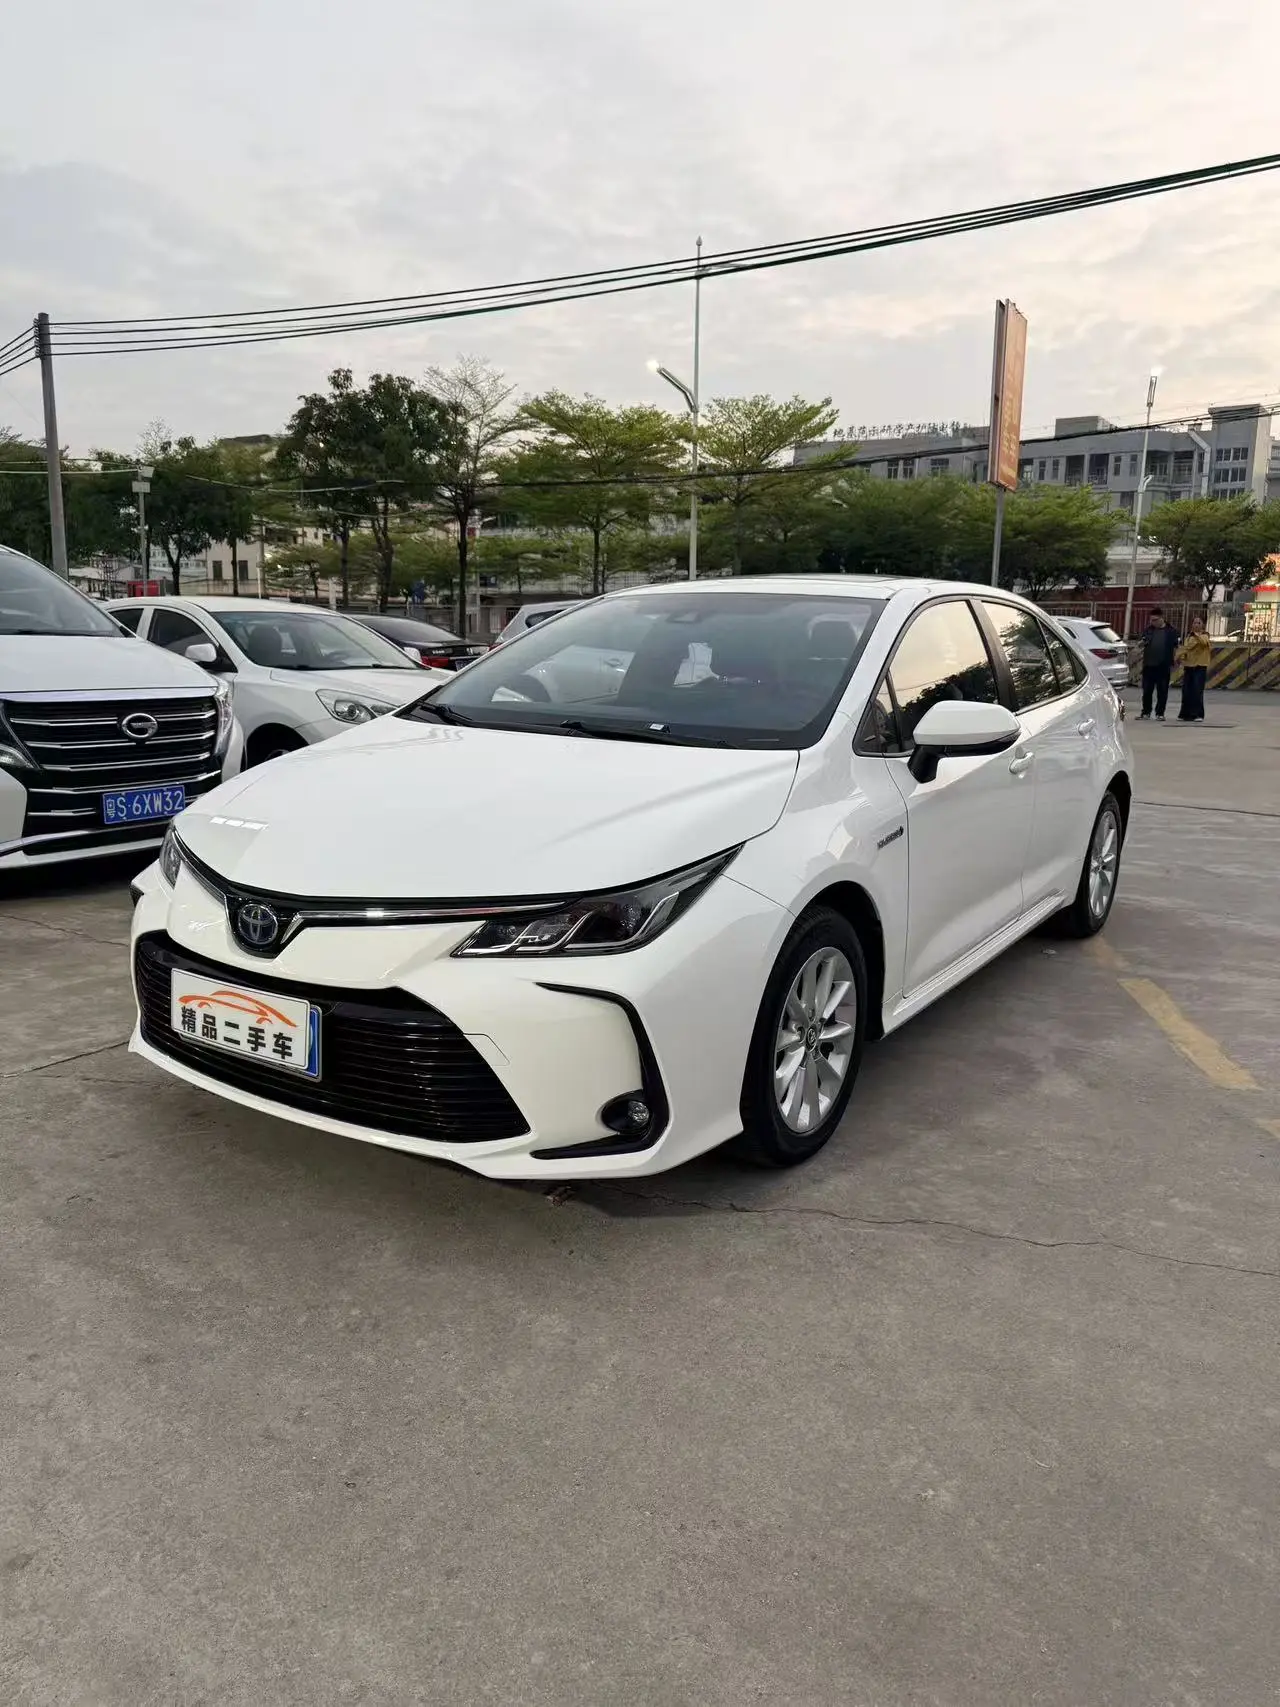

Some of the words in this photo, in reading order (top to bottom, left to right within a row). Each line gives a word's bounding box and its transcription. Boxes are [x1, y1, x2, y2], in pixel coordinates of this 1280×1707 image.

[181, 1006, 292, 1059] 精品二手车
